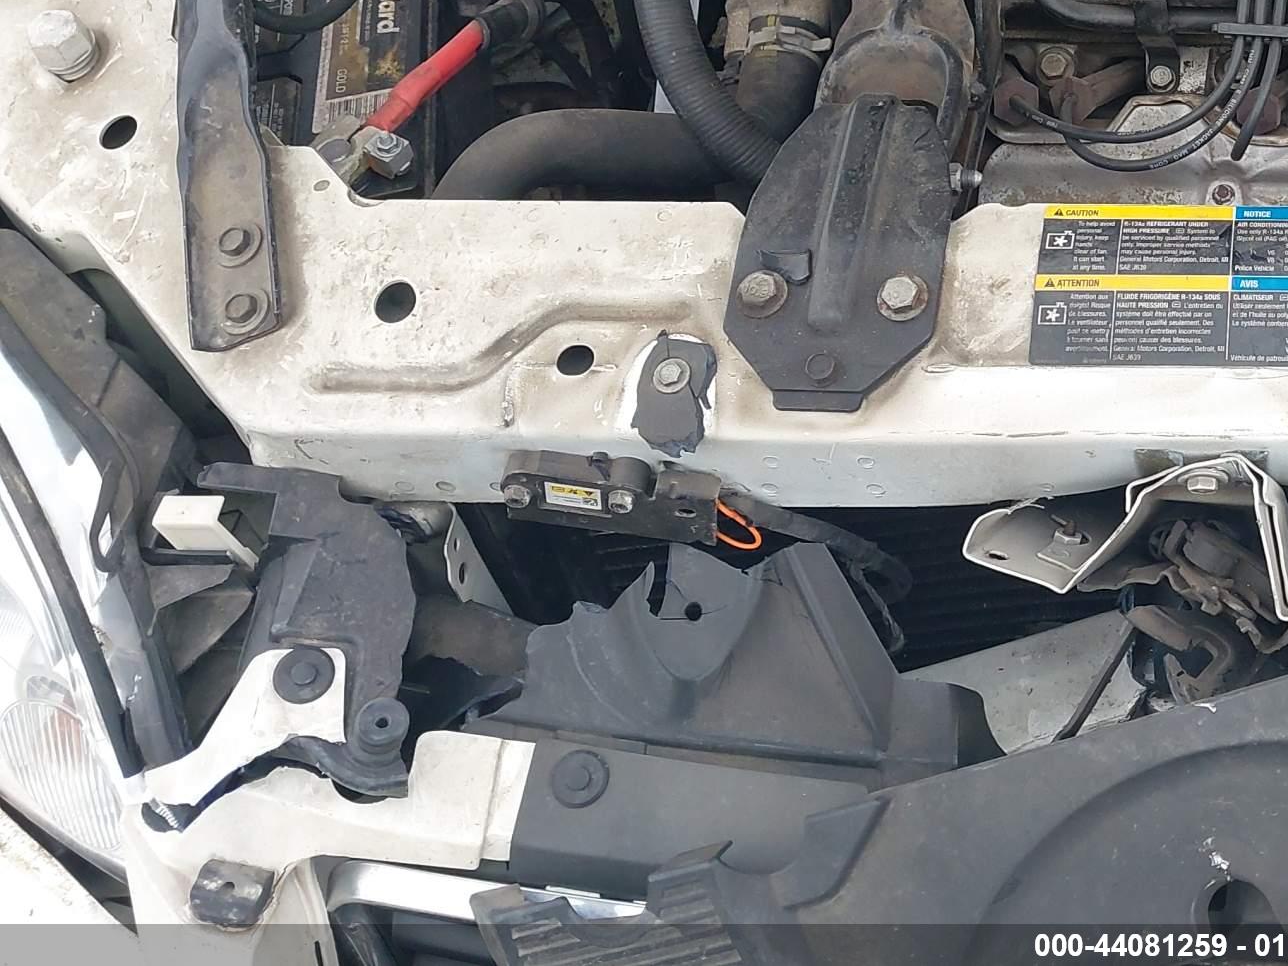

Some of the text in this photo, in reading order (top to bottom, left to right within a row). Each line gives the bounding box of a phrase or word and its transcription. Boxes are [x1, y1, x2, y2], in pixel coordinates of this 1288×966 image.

[335, 68, 348, 93] GOLD
[1215, 98, 1237, 126] SILICONE
[1192, 128, 1213, 150] JACKET
[1057, 279, 1099, 287] ATTENTION
